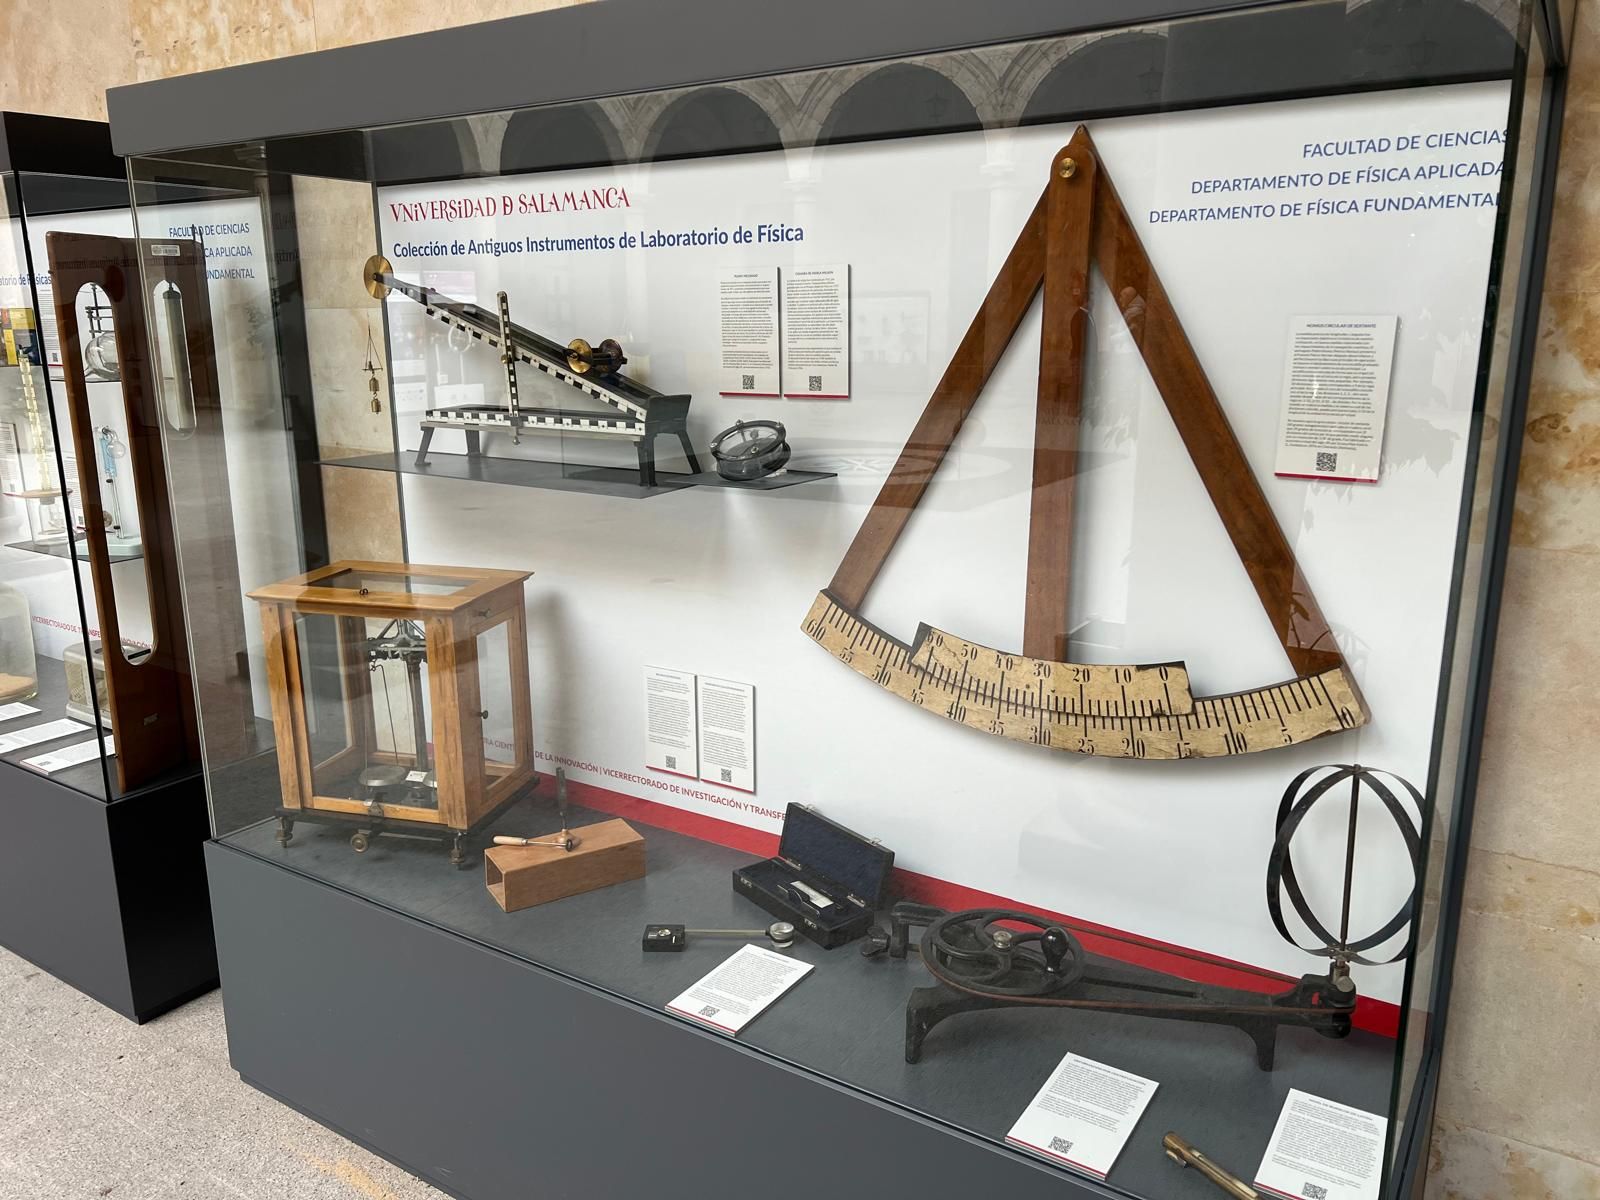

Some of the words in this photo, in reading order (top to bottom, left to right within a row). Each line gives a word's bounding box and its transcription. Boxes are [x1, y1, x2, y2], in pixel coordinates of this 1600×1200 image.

[1303, 138, 1390, 158] FACULTAD
[1396, 135, 1420, 151] DE
[1191, 173, 1323, 194] DEPARTAMENTO
[1327, 171, 1351, 186] DE
[1355, 166, 1410, 184] FÍSICA
[518, 186, 630, 214] SALAMANCA
[1149, 204, 1276, 223] DEPARTAMENTO
[1280, 203, 1302, 217] DE
[1307, 198, 1358, 215] FÍSICA
[169, 226, 203, 238] FACULTAD
[205, 225, 215, 236] DE
[216, 223, 250, 235] CIENCIAS
[393, 239, 447, 258] Colección
[450, 239, 465, 256] de
[468, 237, 523, 258] Antiguos
[526, 233, 615, 254] Instrumentos
[619, 231, 636, 249] de
[641, 227, 728, 248] Laboratorio
[733, 226, 752, 244] de
[757, 224, 804, 243] Física
[216, 246, 253, 257] APLICADA
[961, 644, 978, 660] 50
[995, 654, 1013, 671] 40
[1033, 662, 1051, 678] 30
[1073, 667, 1090, 683] 20
[1115, 668, 1132, 683] 10
[1159, 666, 1168, 681] 0
[806, 619, 826, 642] 60
[839, 647, 854, 664] 55
[872, 664, 892, 687] 50
[911, 688, 925, 705] 45
[946, 701, 967, 723] 40
[989, 720, 1005, 736] 35
[1029, 726, 1051, 746] 30
[1078, 738, 1094, 754] 25
[1122, 738, 1145, 758] 20
[1177, 743, 1192, 759] 15
[1223, 732, 1247, 754] 10
[1280, 728, 1292, 744] 5
[535, 750, 545, 759] DE
[545, 753, 553, 761] LA
[554, 756, 598, 772] INNOVACIÓN
[602, 768, 668, 791] VICERRECTORADO
[669, 784, 680, 794] DE
[682, 788, 742, 809] INVESTIGACIÓN
[743, 803, 750, 812] Y
